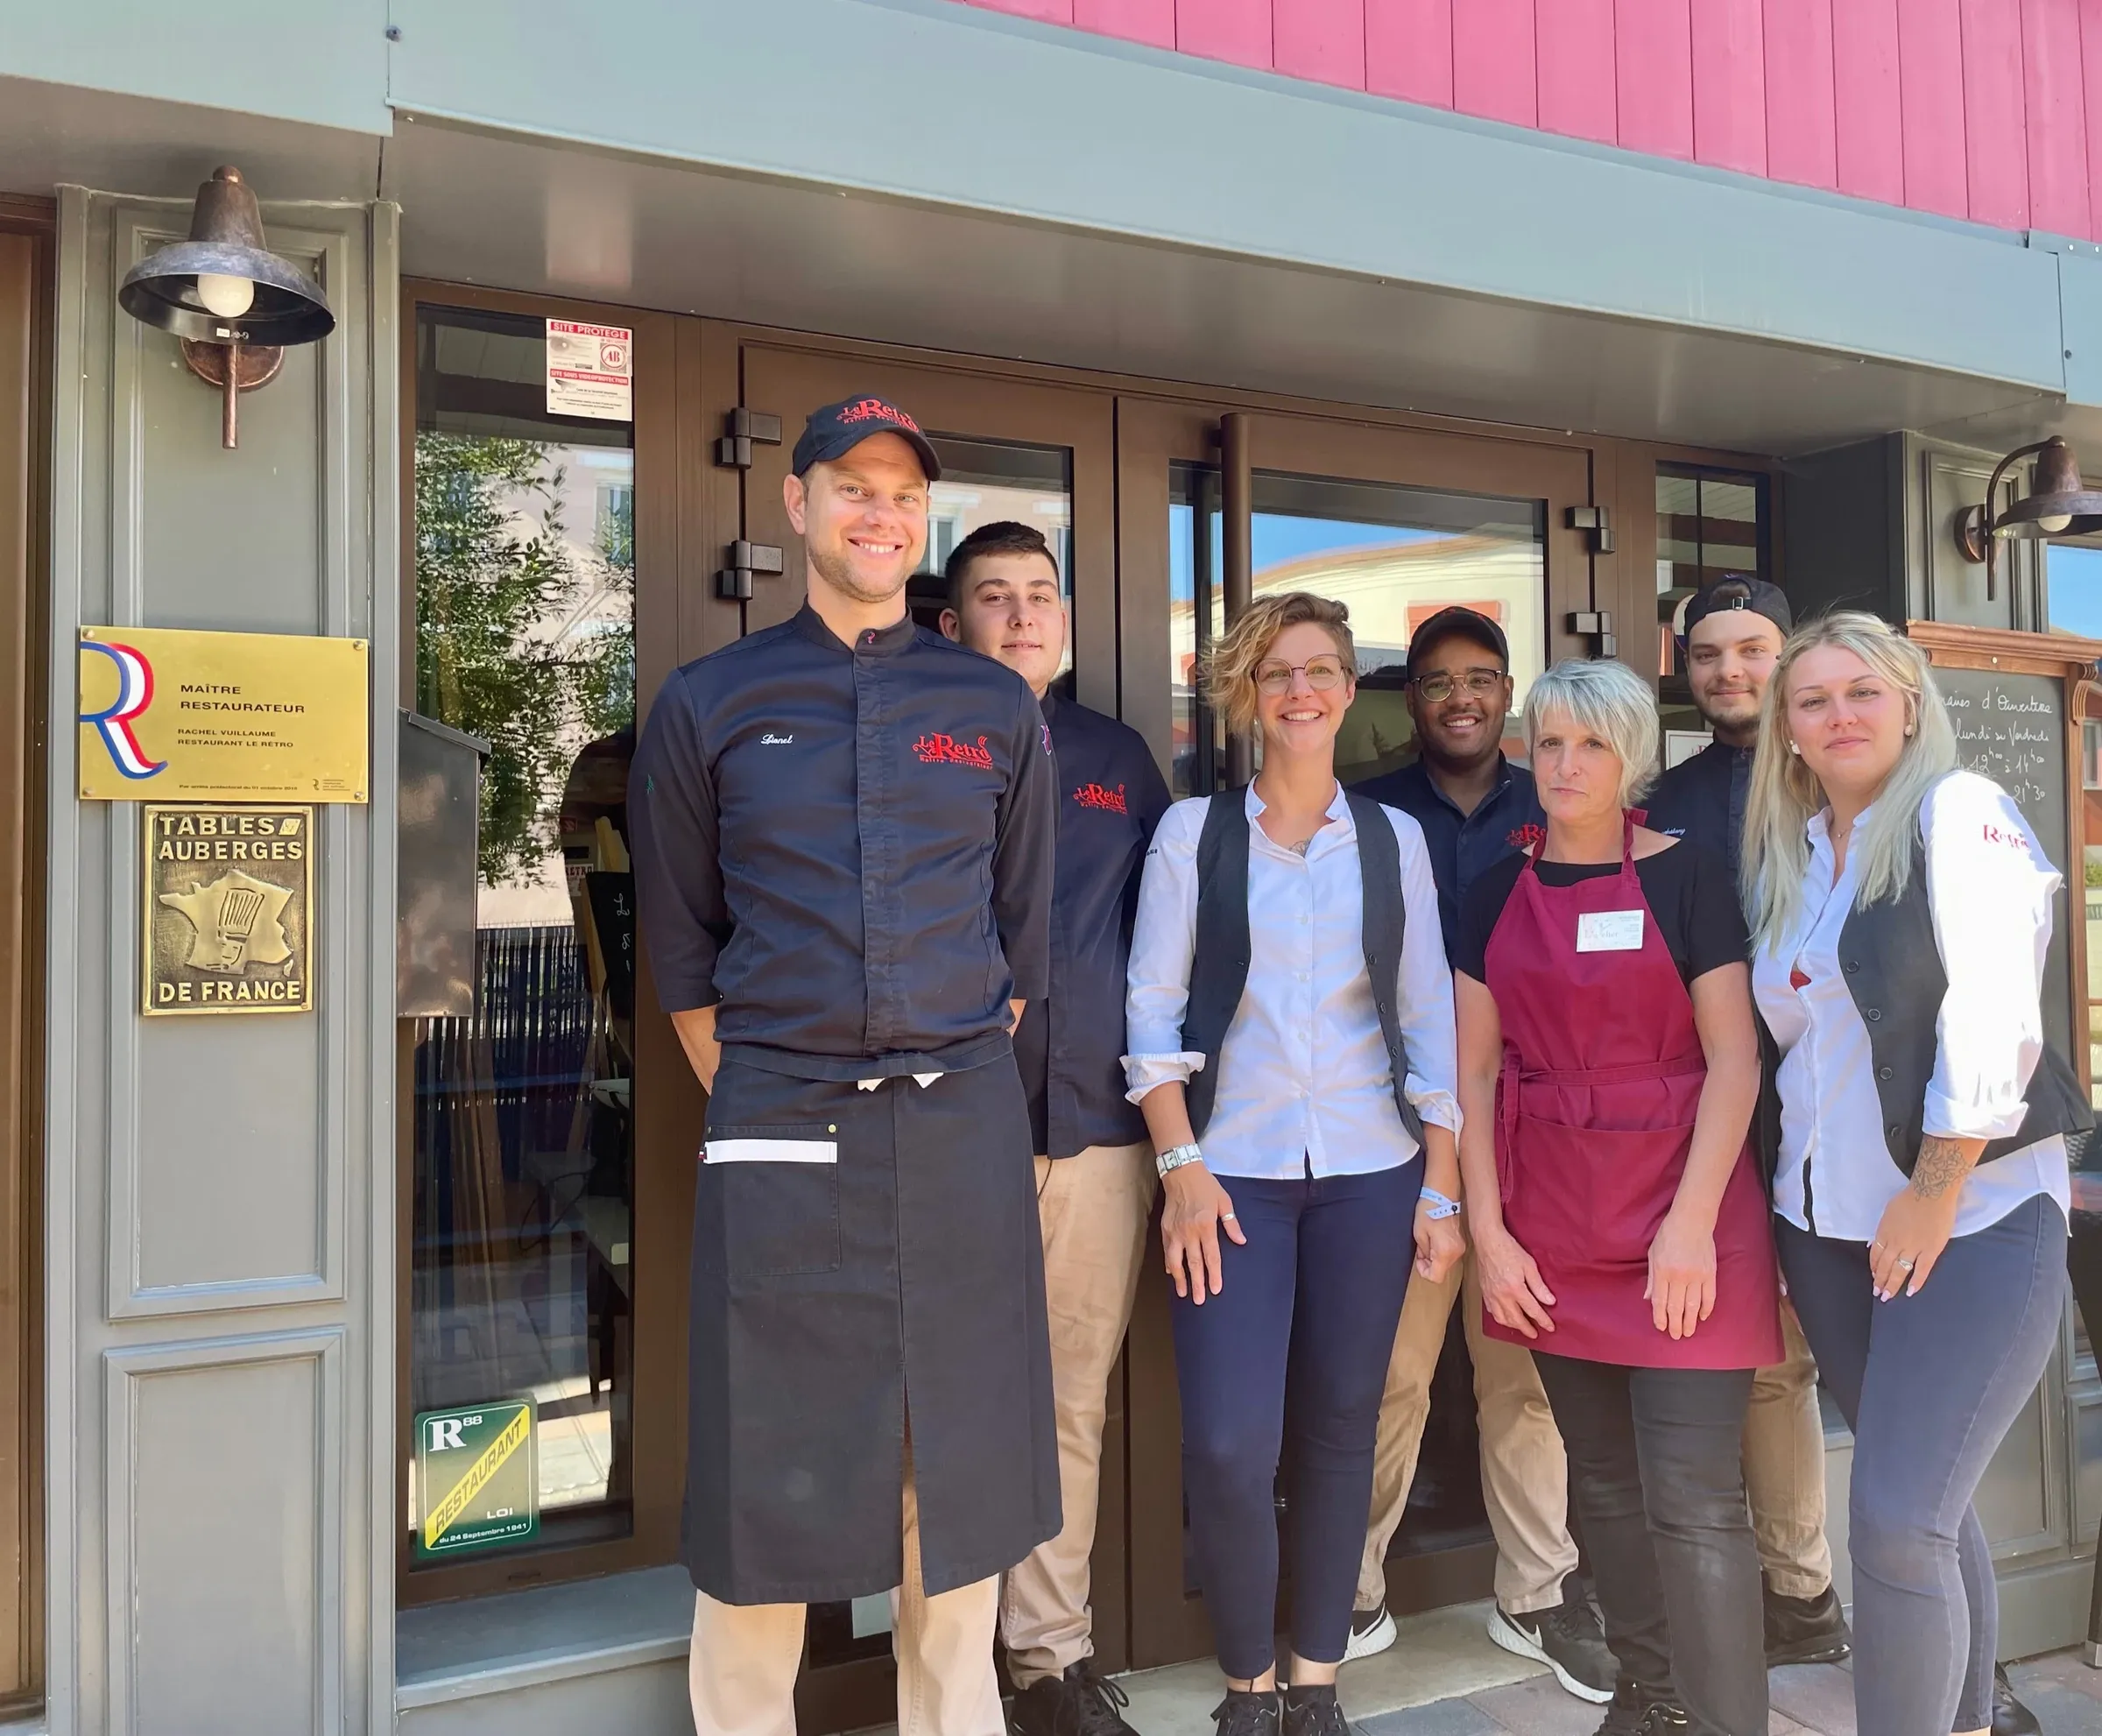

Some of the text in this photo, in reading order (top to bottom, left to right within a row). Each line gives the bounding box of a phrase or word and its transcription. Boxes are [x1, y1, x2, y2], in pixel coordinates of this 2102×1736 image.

[554, 322, 575, 333] SITE
[605, 350, 620, 363] AB
[551, 369, 562, 378] SITE
[563, 370, 578, 379] SOUS
[180, 683, 242, 695] MAÎTRE
[180, 701, 306, 713] RESTAURATEUR
[1956, 717, 1991, 740] lundi
[760, 733, 794, 745] Lionel
[919, 736, 935, 749] Le
[159, 817, 275, 836] TABLES
[159, 841, 303, 860] AUBERGES
[159, 980, 301, 1002] DE FRANCE
[428, 1415, 483, 1452] R 88
[436, 1418, 522, 1535] RESTAURANT
[487, 1507, 513, 1520] LOI
[462, 1528, 505, 1540] Septembre
